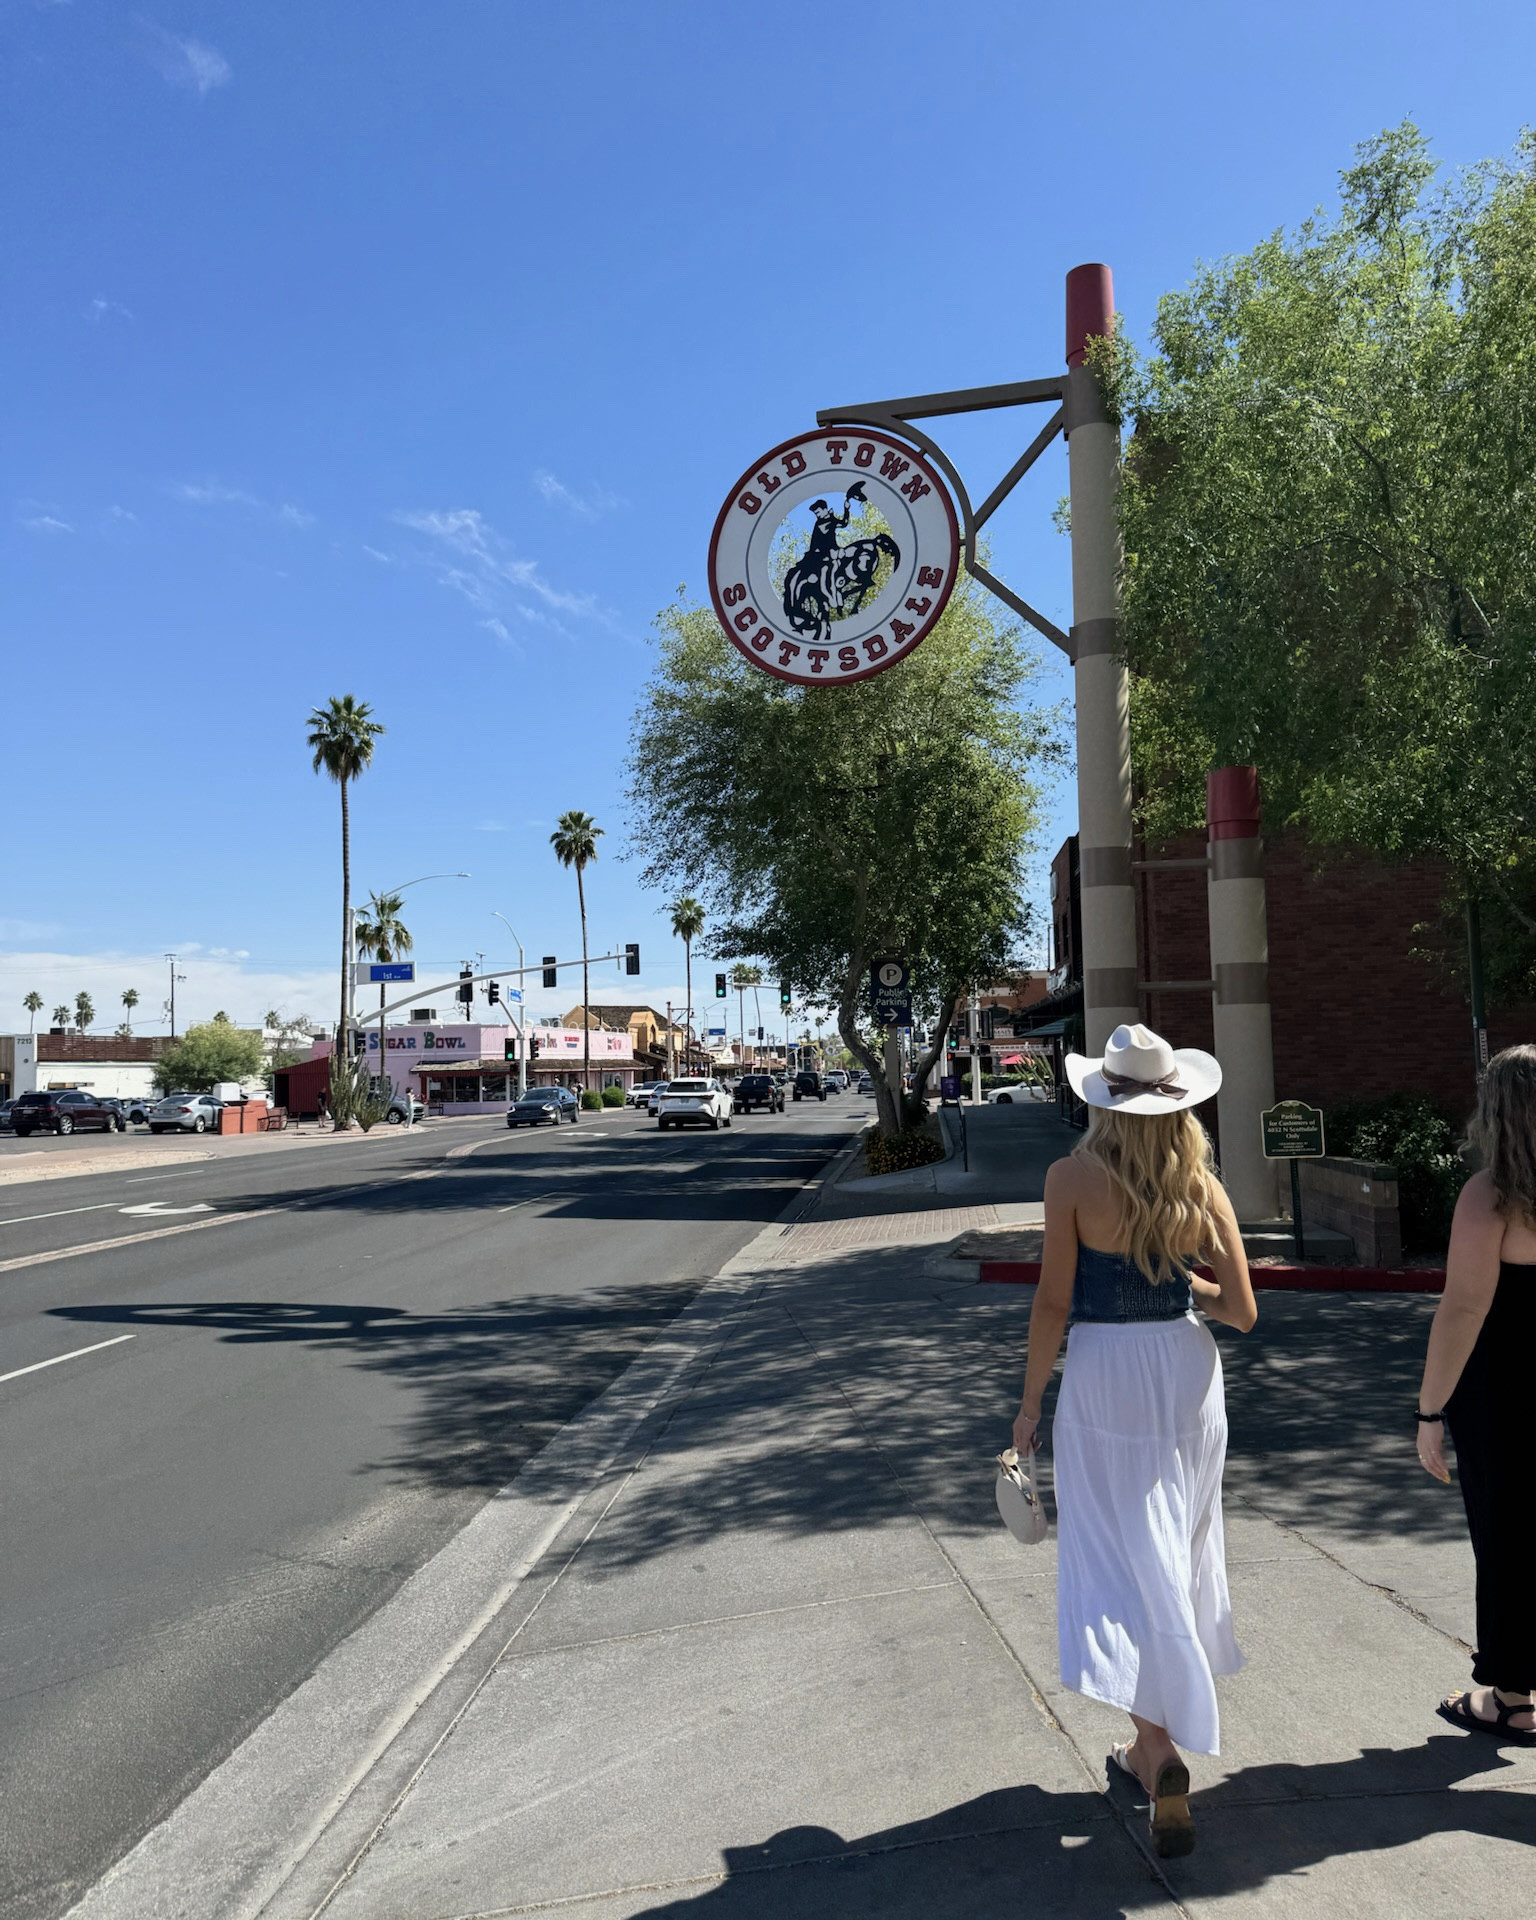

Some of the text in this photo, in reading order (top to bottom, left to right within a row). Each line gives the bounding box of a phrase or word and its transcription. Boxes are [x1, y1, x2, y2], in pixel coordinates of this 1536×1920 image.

[738, 441, 931, 515] OLD TOWN
[723, 566, 944, 673] SCOTTSDALE
[886, 968, 897, 980] P
[878, 988, 904, 997] Public
[876, 998, 908, 1008] Parking
[423, 1031, 466, 1049] BOWL
